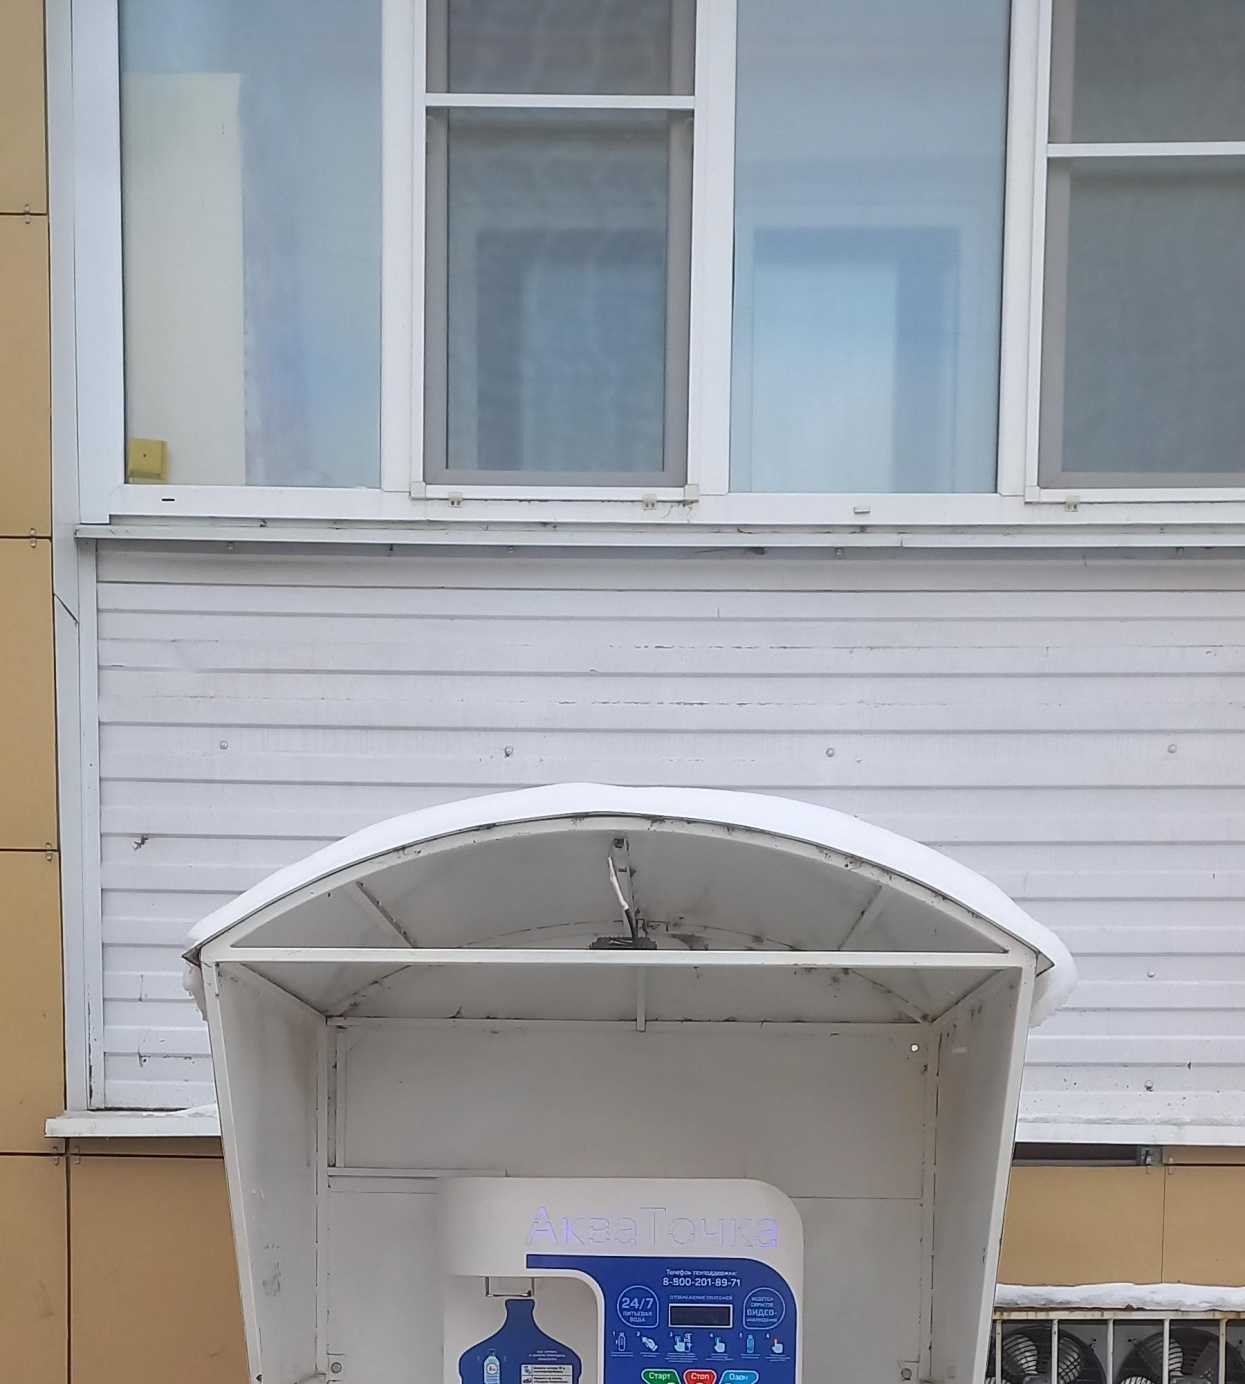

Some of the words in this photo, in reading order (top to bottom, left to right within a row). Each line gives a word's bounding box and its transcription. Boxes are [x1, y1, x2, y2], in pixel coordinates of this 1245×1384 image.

[527, 1205, 779, 1249] АкваТочка
[621, 1297, 654, 1310] 24/7
[648, 1371, 671, 1381] Старт
[690, 1372, 710, 1380] Стоп
[729, 1372, 749, 1380] Озон
